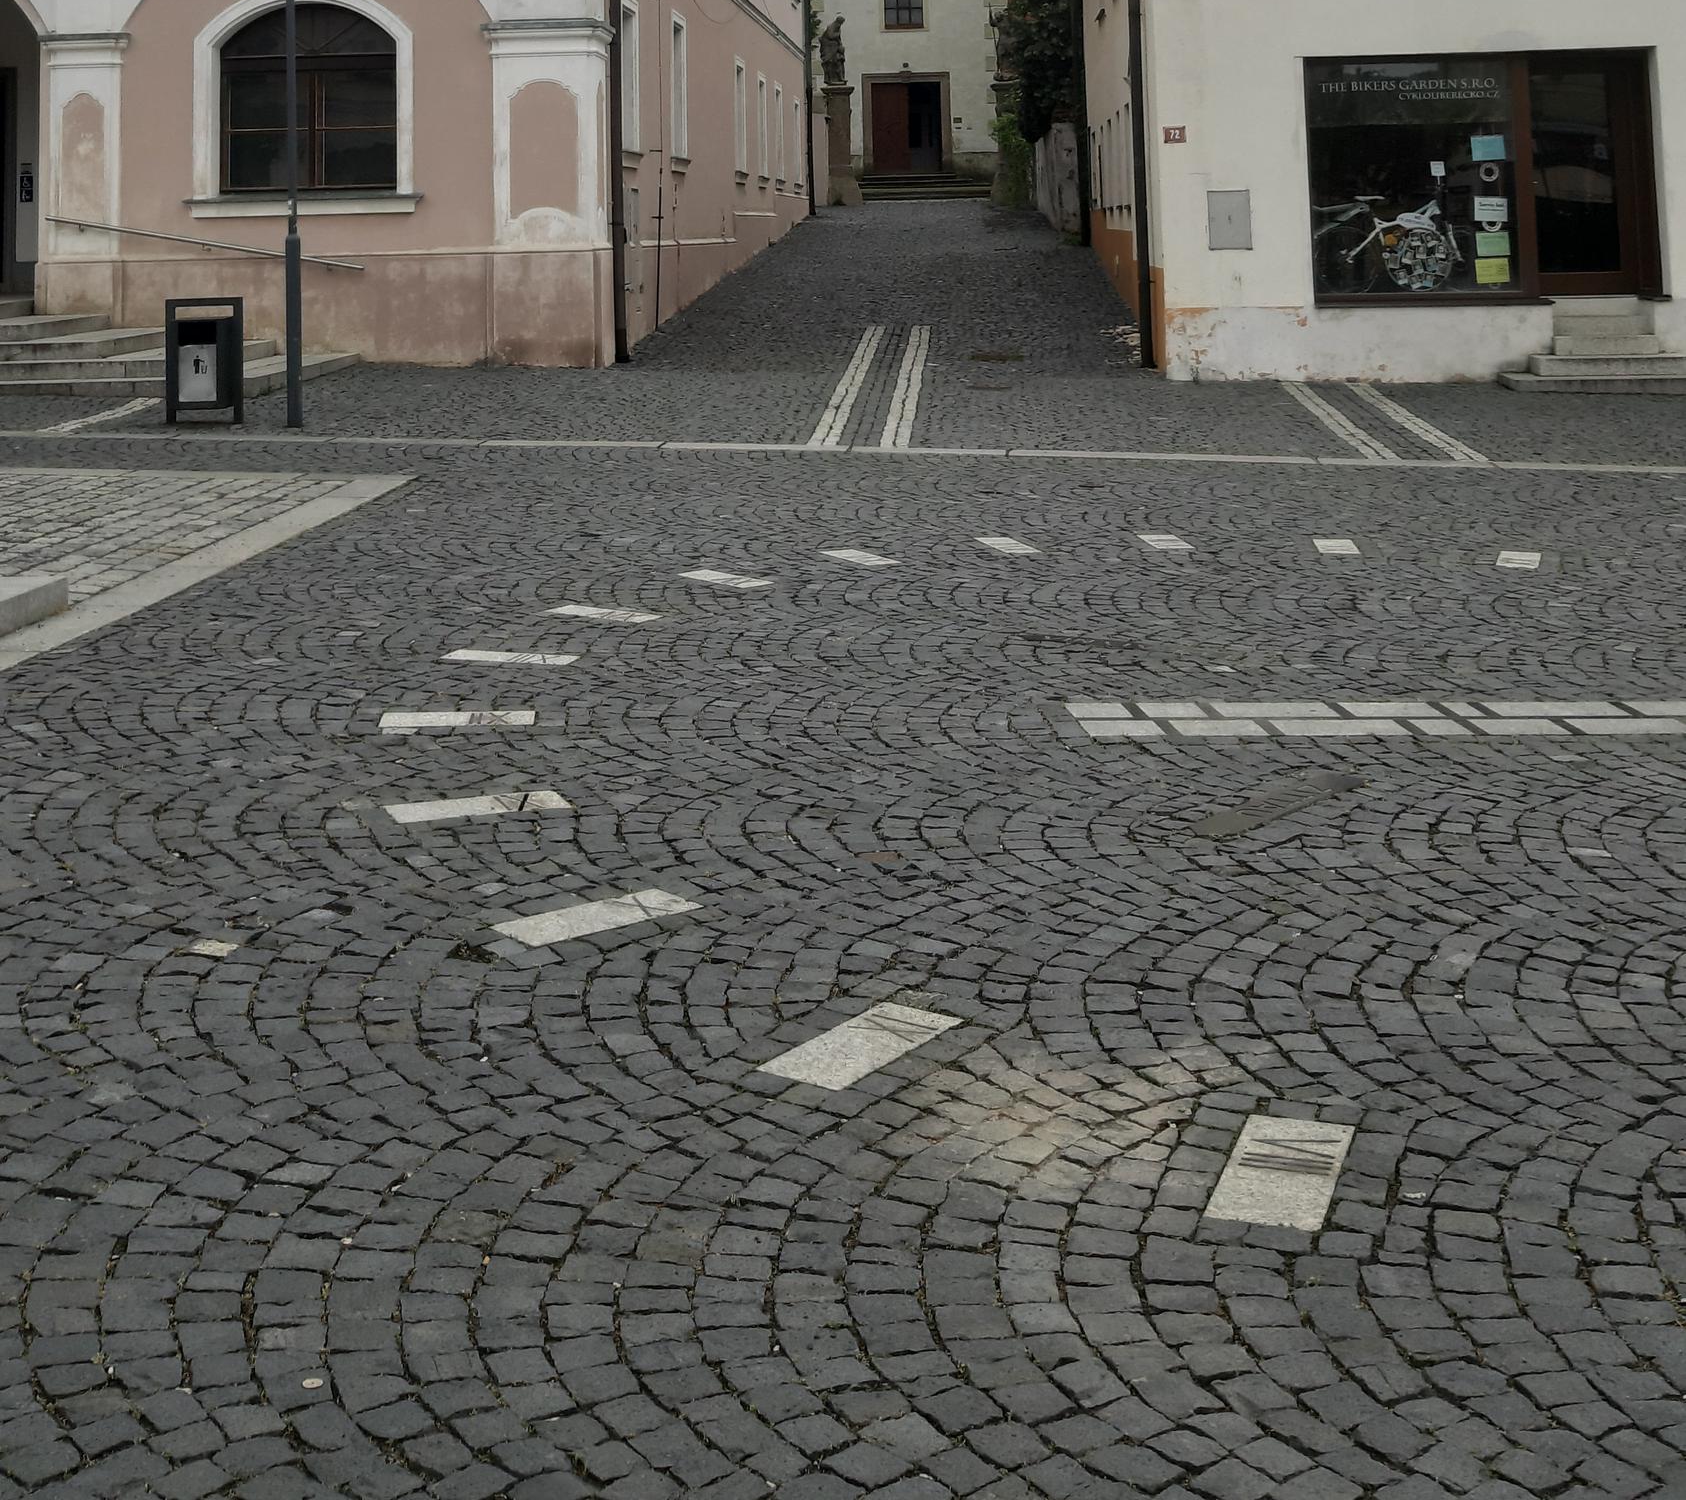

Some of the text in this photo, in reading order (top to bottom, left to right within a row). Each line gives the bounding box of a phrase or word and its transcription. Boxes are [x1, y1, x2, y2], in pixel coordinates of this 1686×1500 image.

[1318, 82, 1347, 93] THE
[1351, 81, 1396, 92] BIKERS
[1399, 79, 1457, 91] GARDEN
[1169, 129, 1181, 140] 72
[1237, 1138, 1342, 1177] VIII
